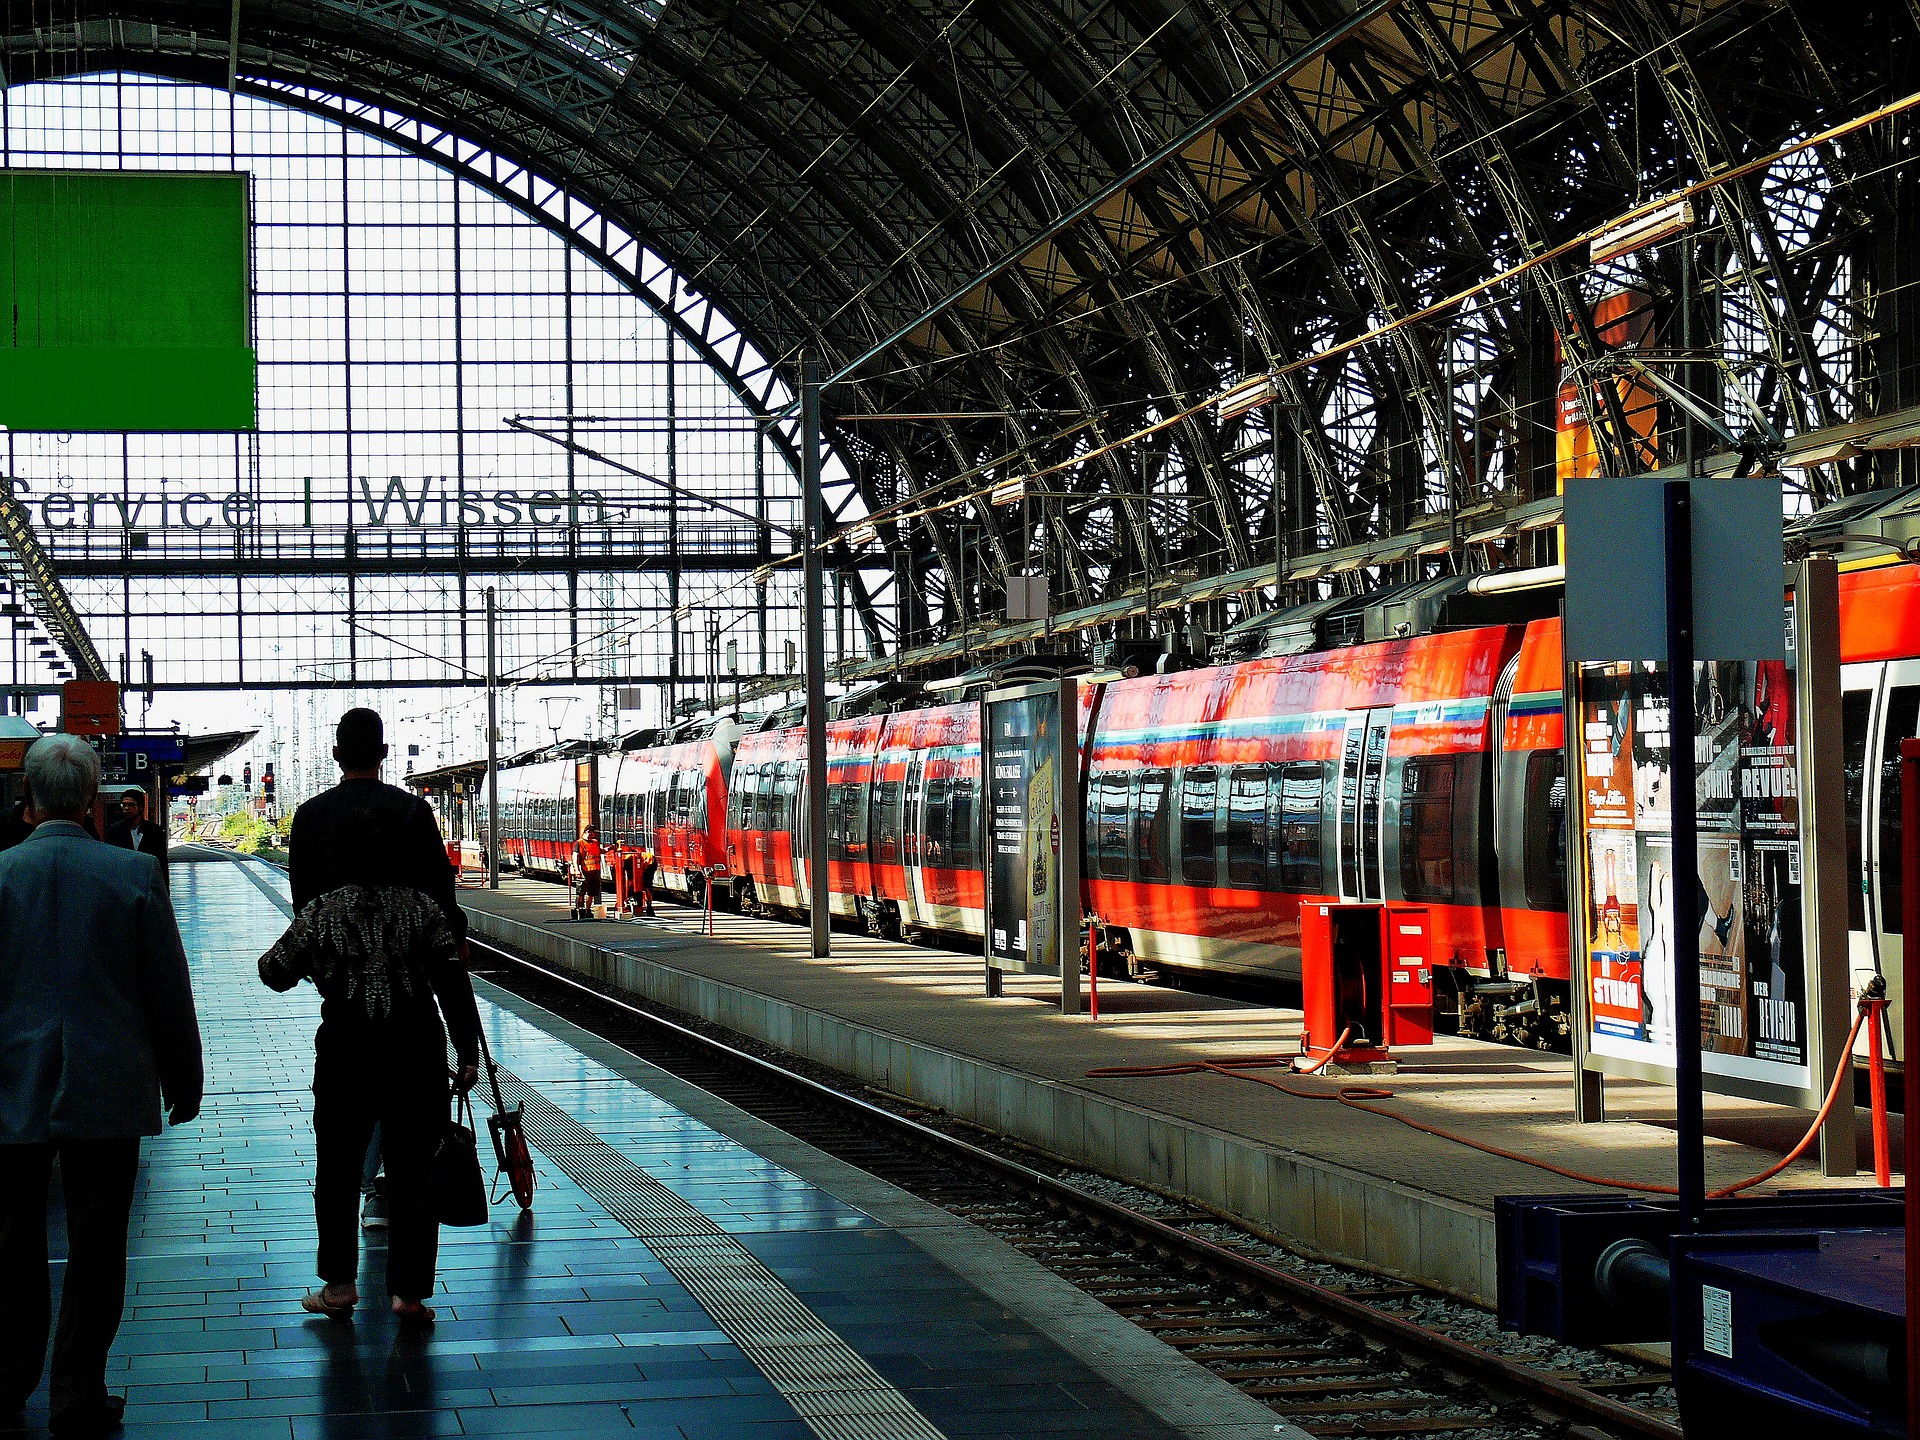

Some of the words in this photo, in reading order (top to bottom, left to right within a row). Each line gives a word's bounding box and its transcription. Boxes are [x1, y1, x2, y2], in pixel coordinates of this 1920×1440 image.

[359, 476, 606, 527] Wissen
[175, 739, 184, 747] 13
[135, 752, 148, 770] B
[1741, 767, 1797, 798] REVUE!
[1593, 976, 1639, 1010] STURM
[1753, 981, 1769, 997] DER
[1759, 998, 1796, 1042] REVISOR
